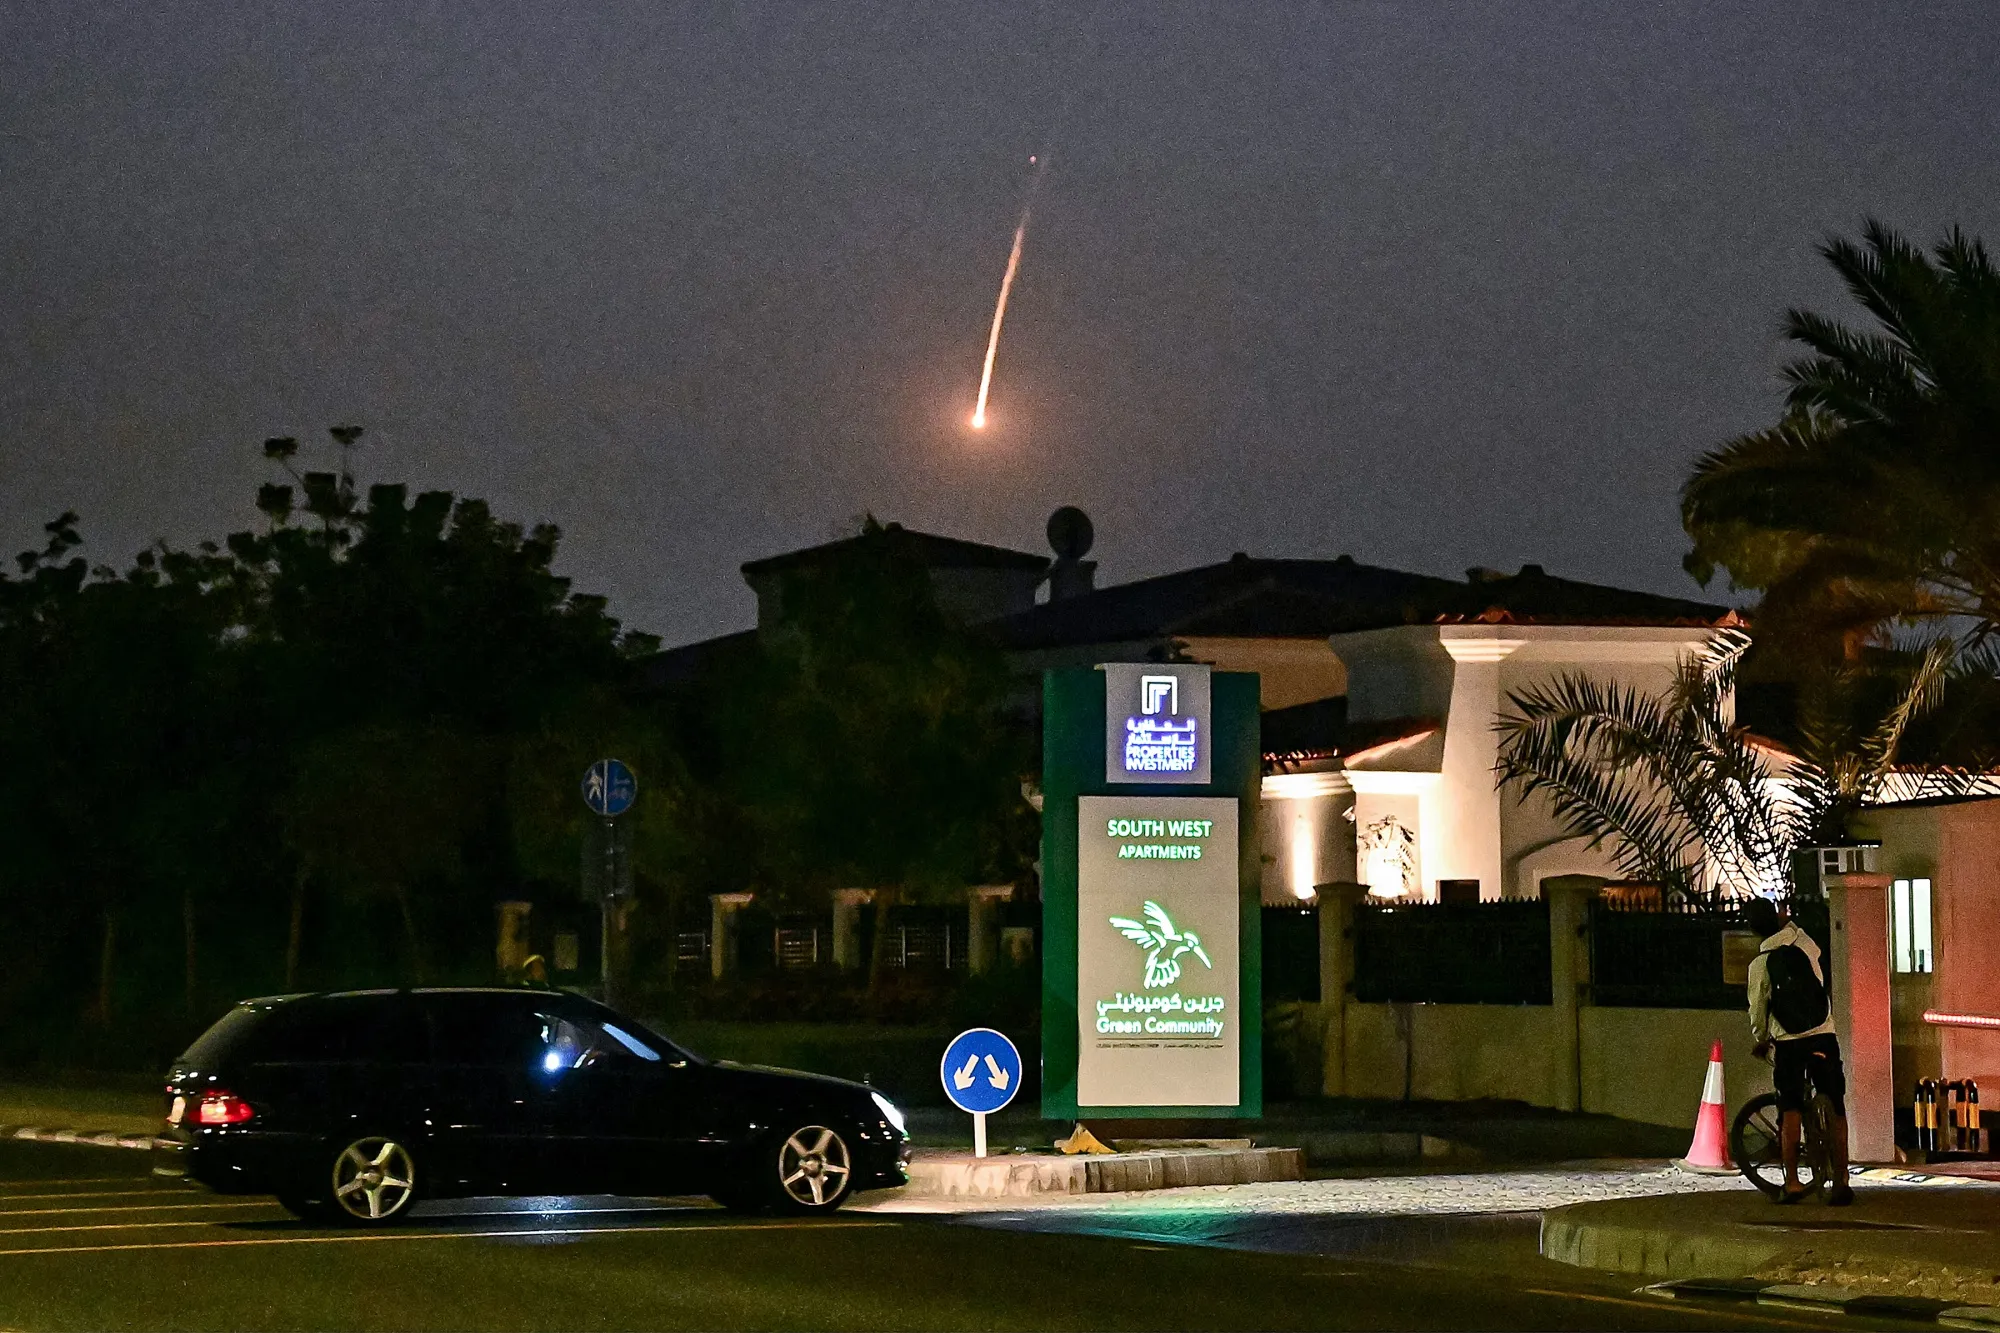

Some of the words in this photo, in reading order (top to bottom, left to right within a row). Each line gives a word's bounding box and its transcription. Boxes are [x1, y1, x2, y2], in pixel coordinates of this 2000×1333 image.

[1126, 746, 1195, 759] PROPERTIES
[1126, 759, 1195, 771] INVESTMENT
[1107, 819, 1164, 837] SOUTH
[1168, 820, 1212, 837] WEST
[1118, 845, 1202, 859] APARTMENTS
[1096, 992, 1181, 1016] كوميونيتي
[1183, 995, 1225, 1013] جرين
[1096, 1016, 1142, 1033] Green
[1144, 1016, 1224, 1037] Community
